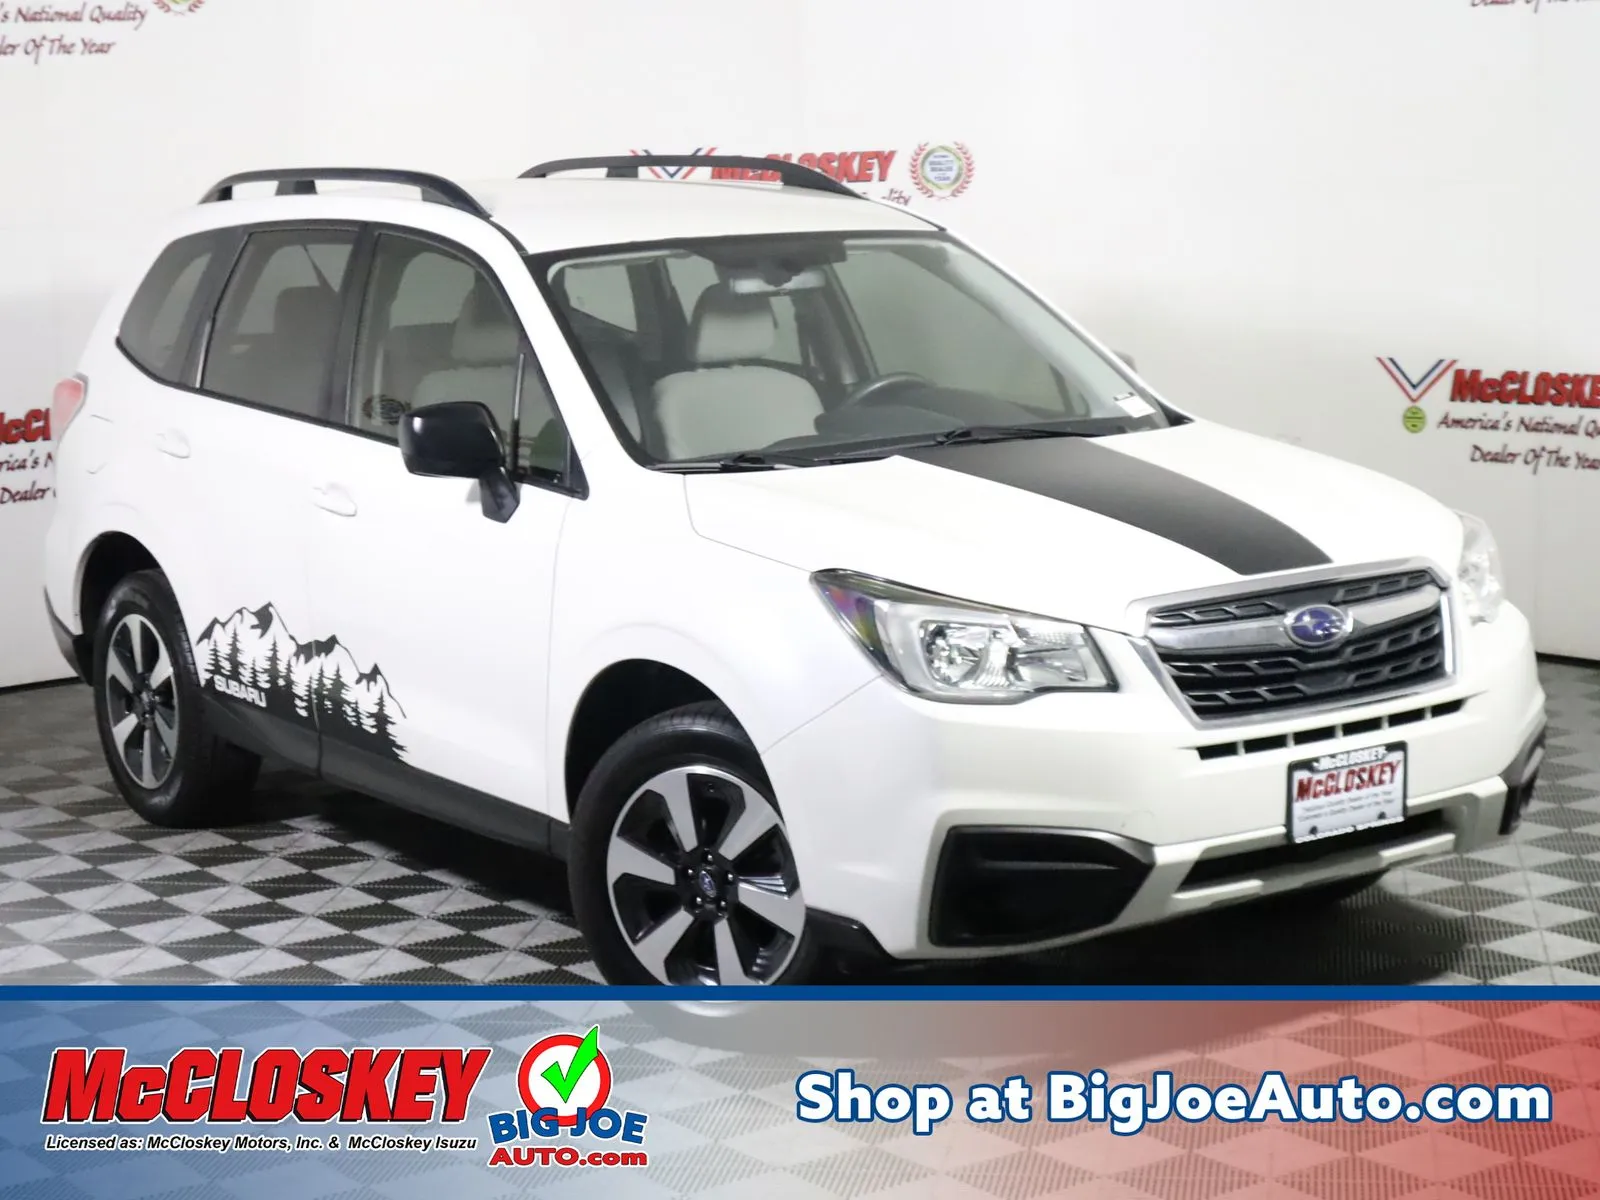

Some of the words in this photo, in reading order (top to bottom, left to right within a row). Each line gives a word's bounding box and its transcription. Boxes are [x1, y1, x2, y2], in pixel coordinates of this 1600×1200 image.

[14, 2, 87, 23] National
[90, 1, 147, 31] Quality
[24, 34, 46, 65] Of
[48, 34, 76, 55] The
[80, 37, 116, 55] Year
[1436, 412, 1513, 433] America's
[1516, 414, 1585, 436] National
[1470, 444, 1521, 465] Dealer
[1523, 445, 1546, 475] Of
[1546, 446, 1571, 467] The
[0, 480, 51, 504] Dealer
[213, 674, 267, 708] SUBARU
[1295, 760, 1401, 802] McCLOSKEY
